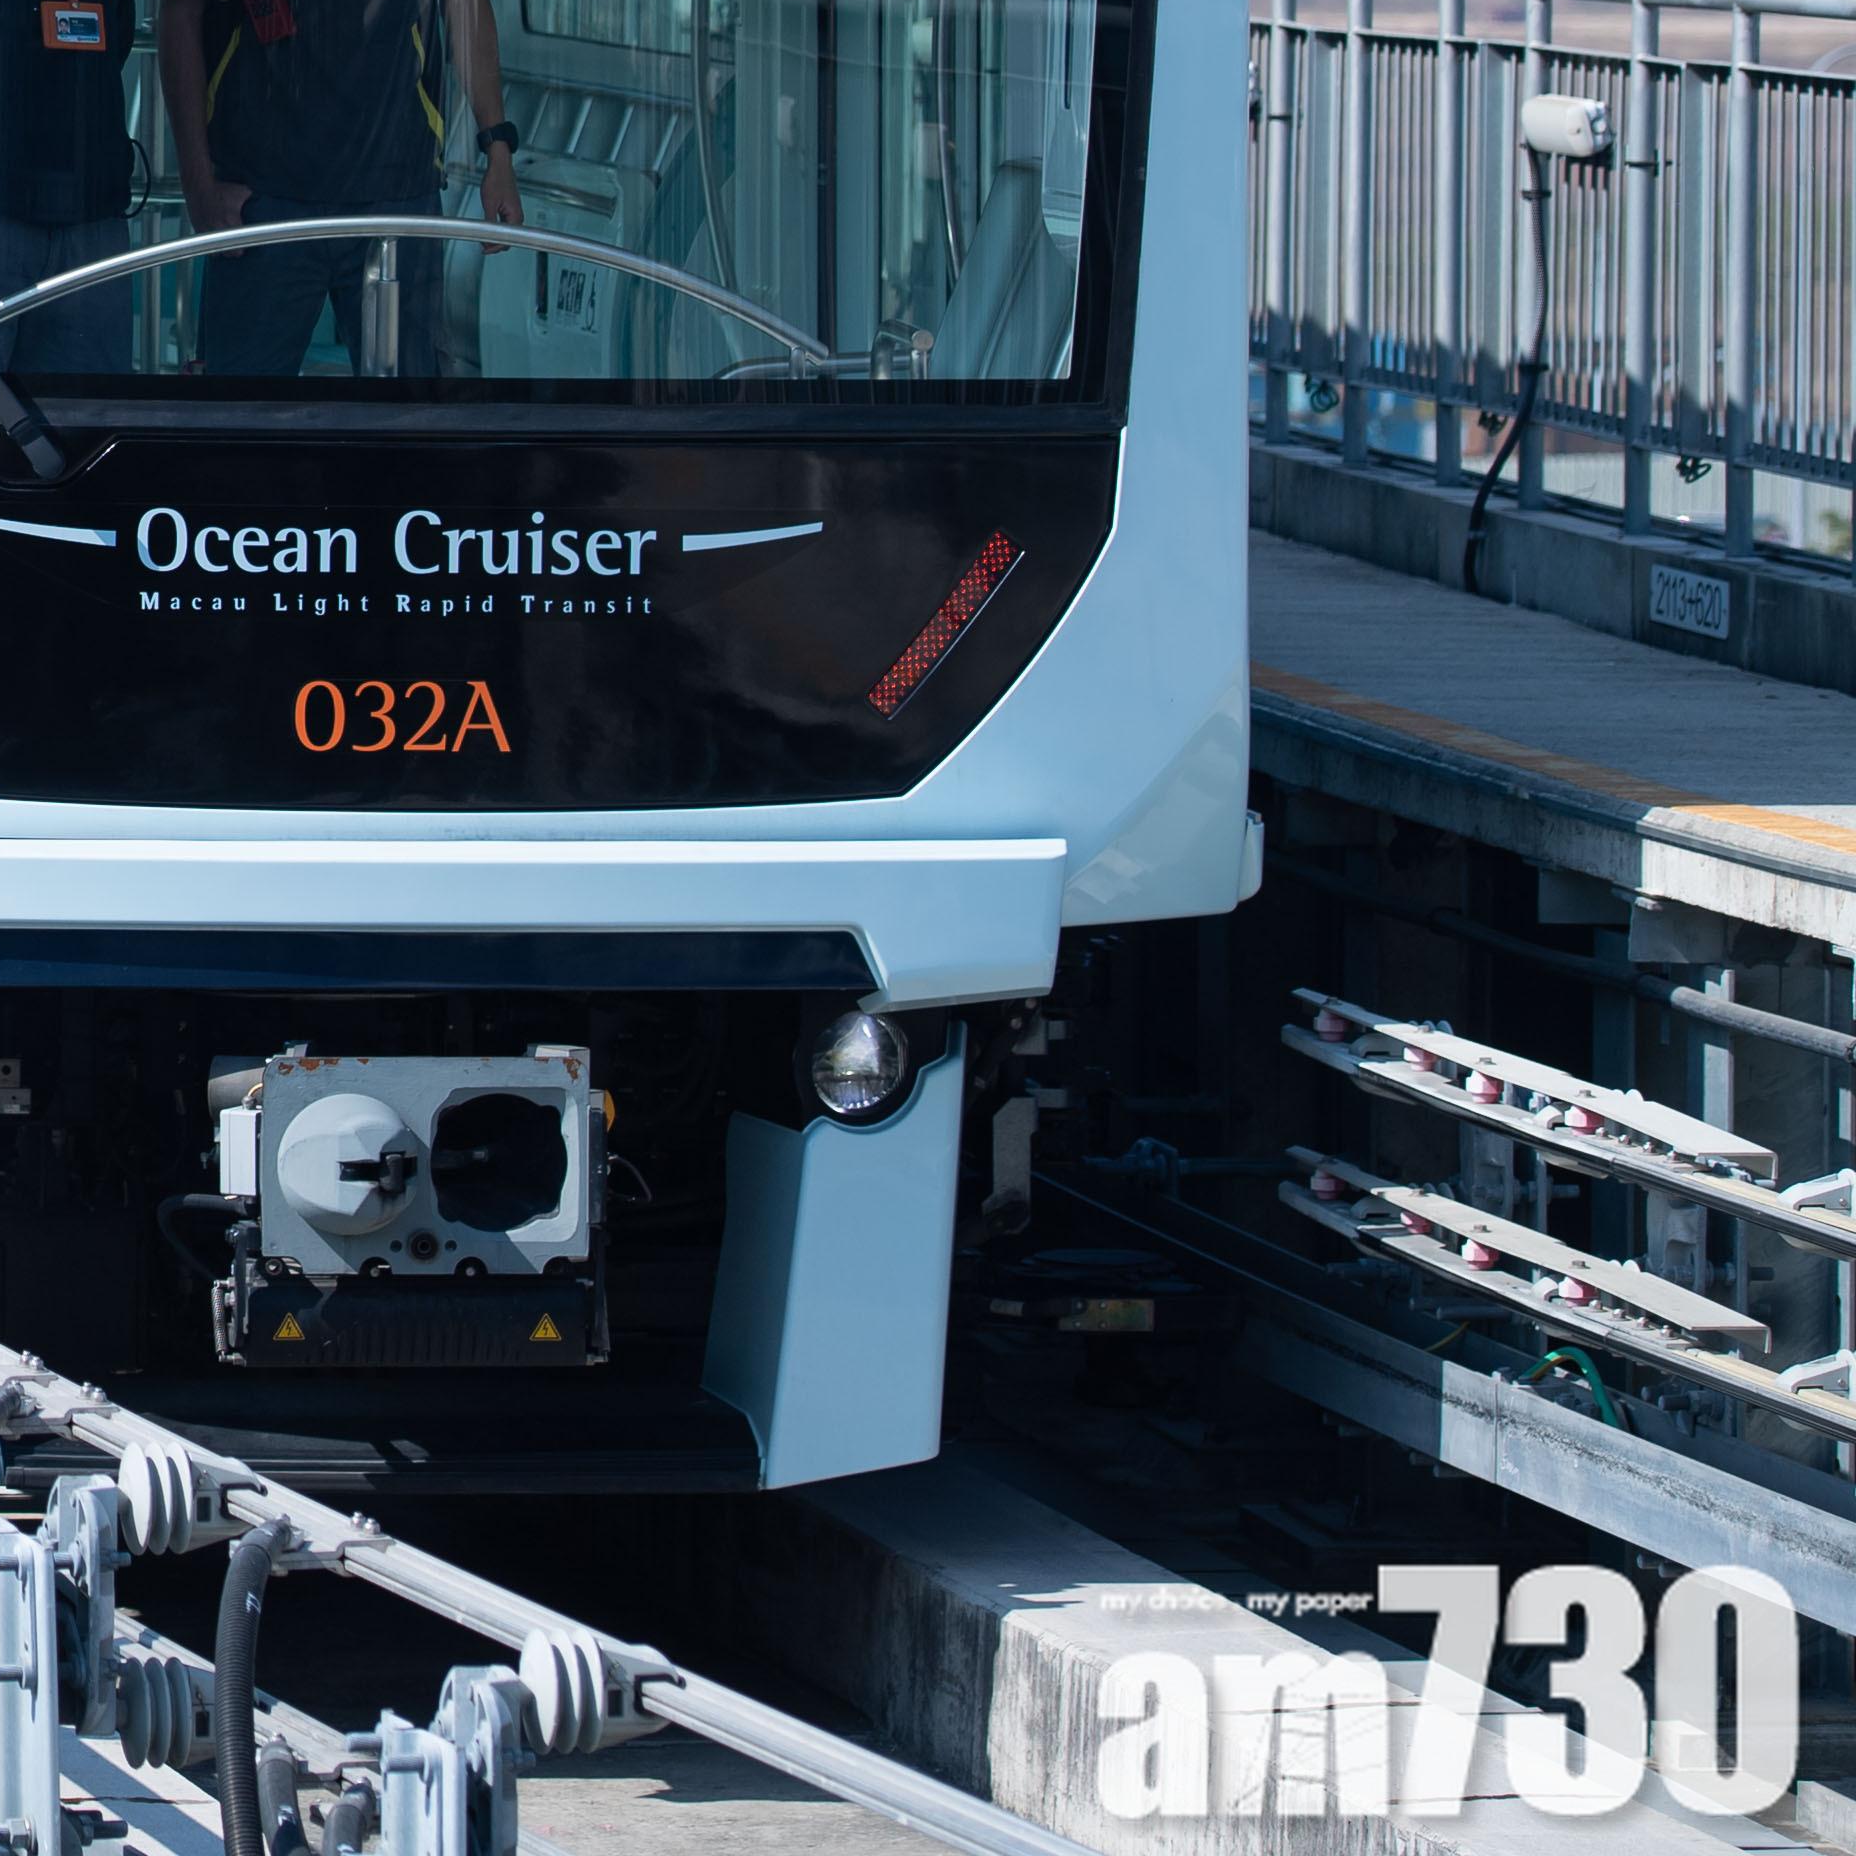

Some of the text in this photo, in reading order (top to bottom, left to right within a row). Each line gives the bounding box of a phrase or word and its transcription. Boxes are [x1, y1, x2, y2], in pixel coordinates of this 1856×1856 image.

[137, 507, 658, 576] Ocean Cruiser
[140, 592, 652, 617] Macau Light Rapid Transit
[295, 681, 512, 753] 032A
